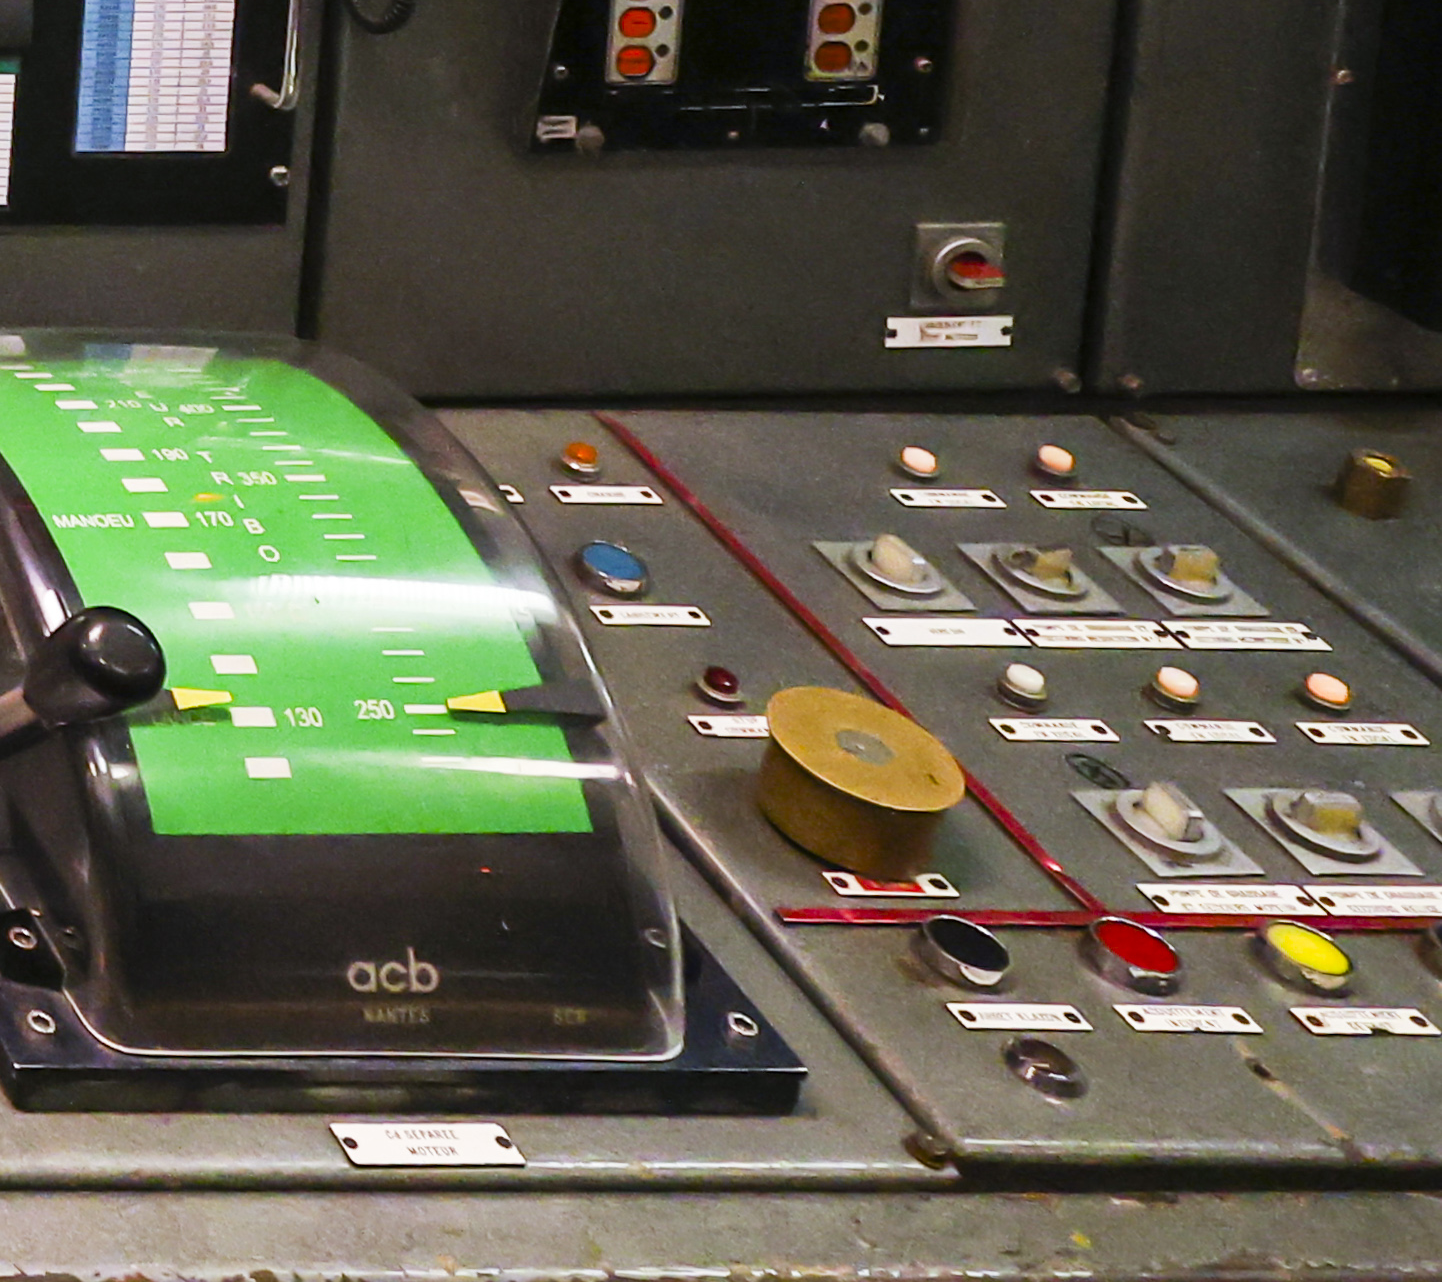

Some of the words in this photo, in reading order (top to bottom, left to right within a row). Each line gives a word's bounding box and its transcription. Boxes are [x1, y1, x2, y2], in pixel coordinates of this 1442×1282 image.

[51, 514, 135, 531] MANOEU
[195, 510, 234, 528] 170
[282, 706, 324, 728] 130
[352, 698, 396, 721] 250
[346, 946, 440, 994] acb
